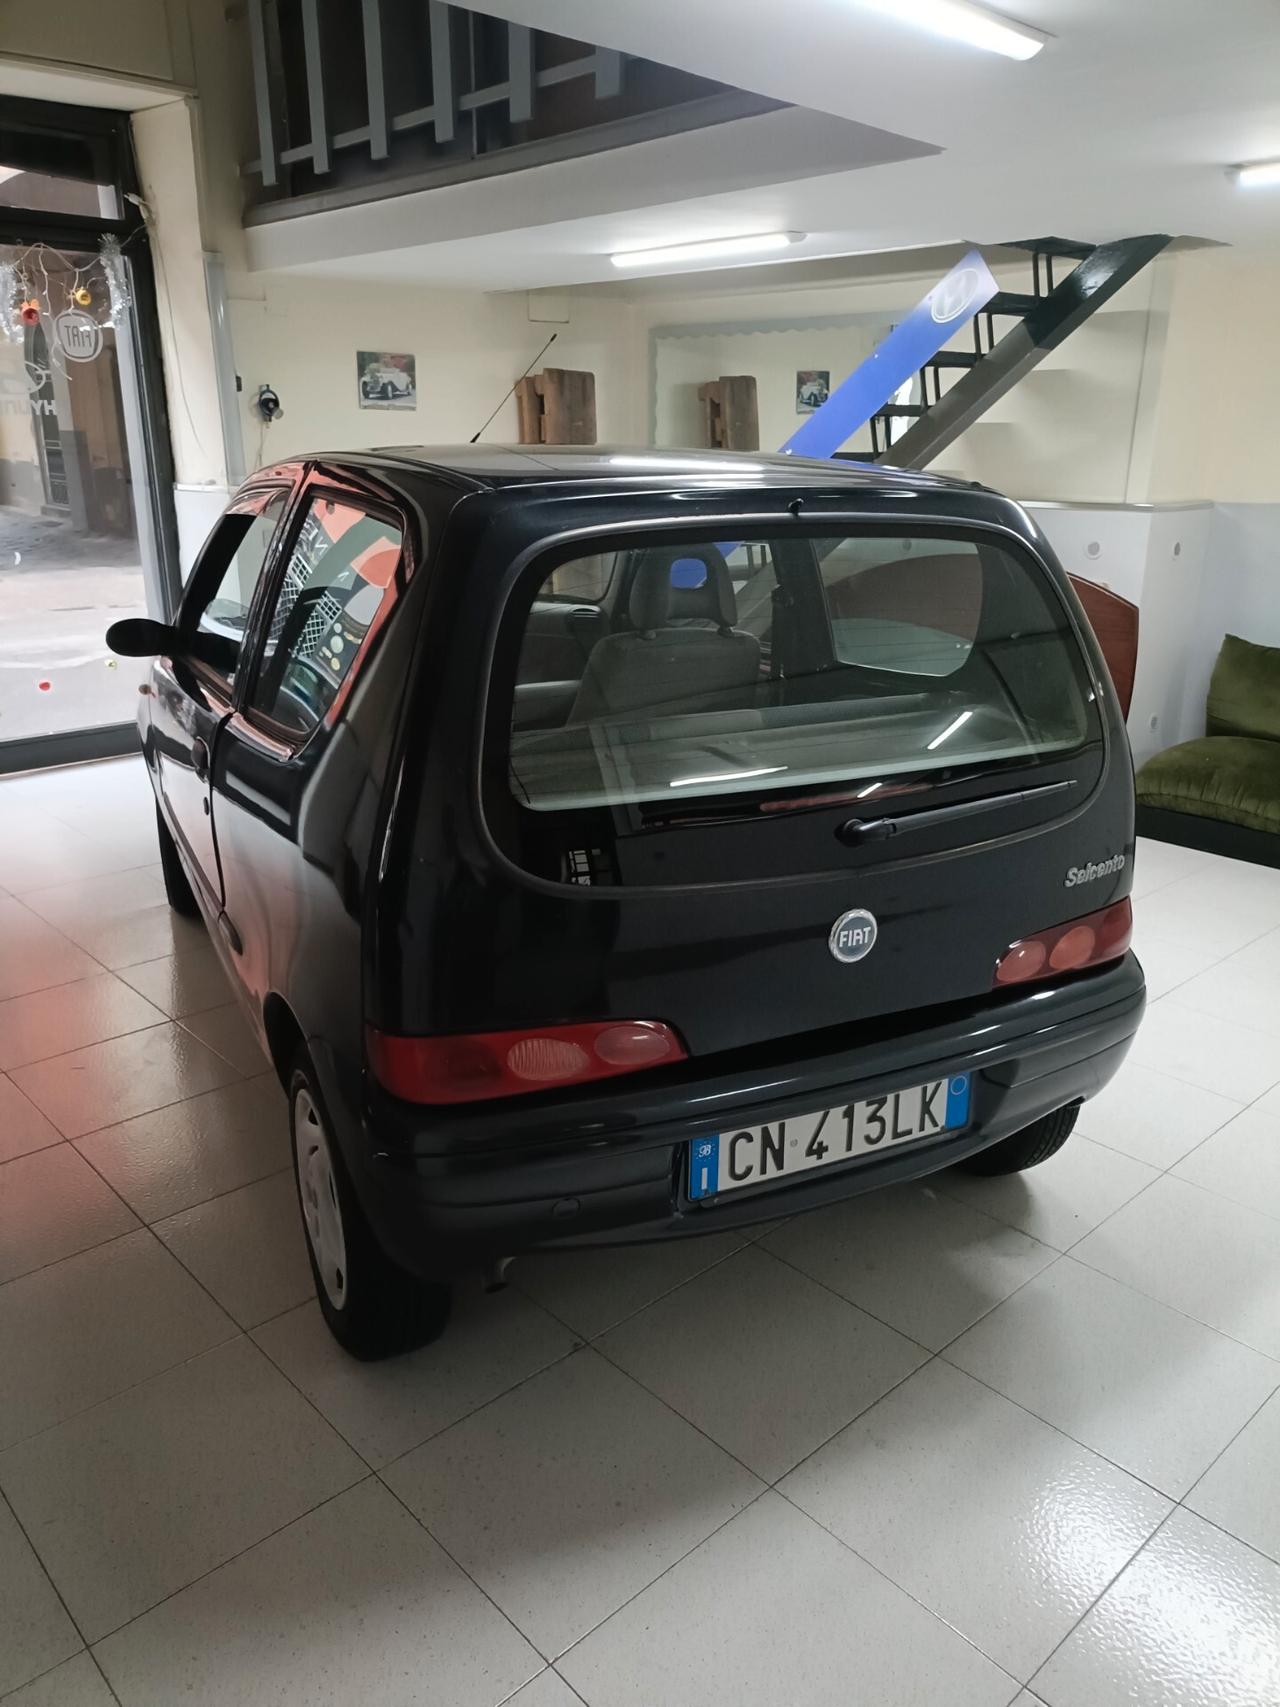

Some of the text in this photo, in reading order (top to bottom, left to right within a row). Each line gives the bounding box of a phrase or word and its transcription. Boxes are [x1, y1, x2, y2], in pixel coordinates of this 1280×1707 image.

[1064, 854, 1126, 887] Seicento
[839, 926, 871, 948] FIAT
[728, 1121, 786, 1182] CN
